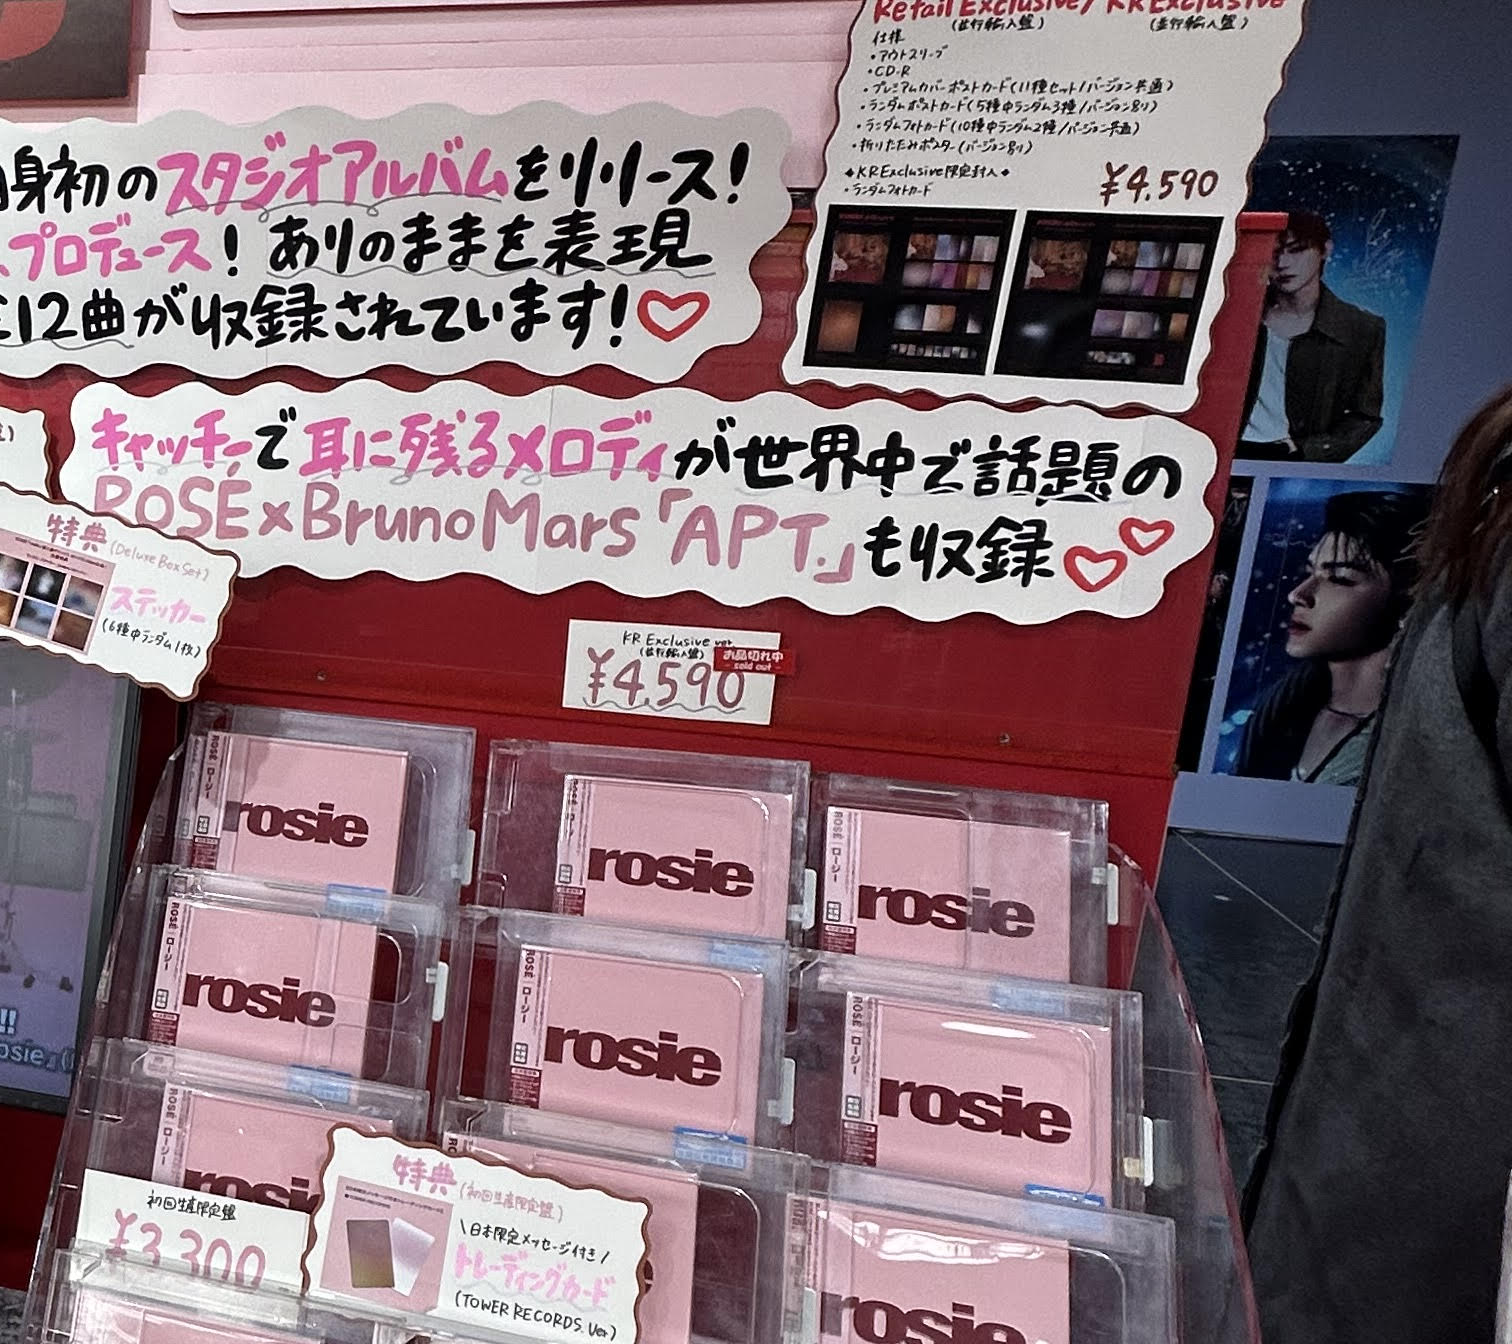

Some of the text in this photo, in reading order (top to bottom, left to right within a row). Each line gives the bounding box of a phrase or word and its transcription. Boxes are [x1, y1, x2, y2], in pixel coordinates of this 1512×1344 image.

[46, 513, 108, 553] 特典
[110, 586, 206, 624] ステッカー
[646, 633, 710, 648] Exclusive
[227, 803, 369, 848] rosie
[589, 848, 754, 898] rosie
[858, 885, 1035, 938] rosie
[183, 973, 336, 1028] rosie
[545, 1025, 722, 1087] rosie
[879, 1078, 1072, 1144] rosie
[183, 1168, 322, 1215] rosi
[392, 1154, 457, 1196] 特典
[147, 1189, 236, 1221] 初回生産限定盤
[455, 1241, 617, 1306] トレーディングカード
